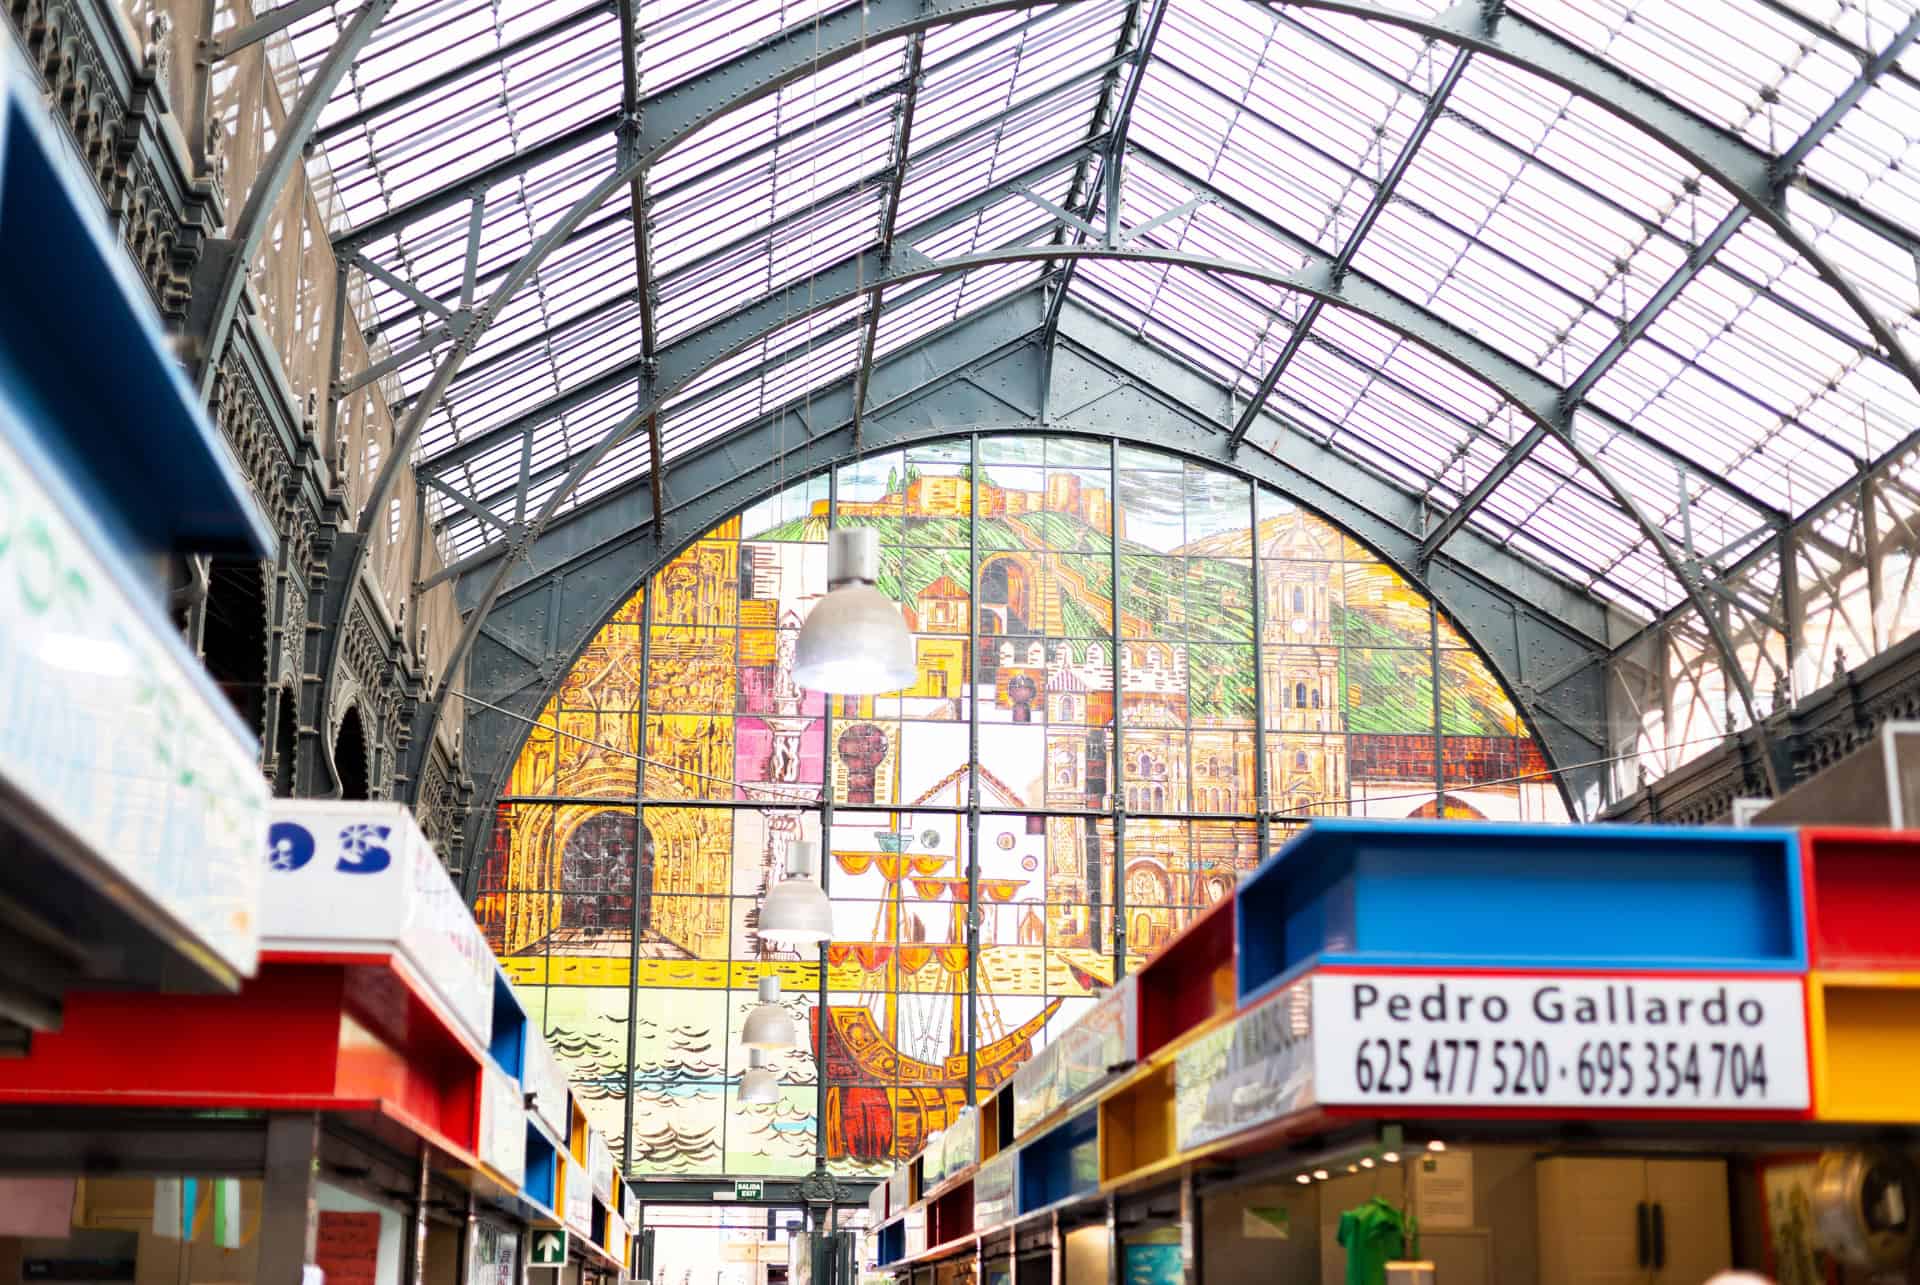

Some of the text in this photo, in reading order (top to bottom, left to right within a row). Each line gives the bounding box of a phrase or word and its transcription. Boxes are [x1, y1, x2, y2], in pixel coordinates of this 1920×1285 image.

[1352, 983, 1765, 1028] Pedro Gallardo
[1354, 1038, 1414, 1095] 625
[1422, 1038, 1481, 1095] 477
[1492, 1038, 1549, 1096] 520
[1576, 1041, 1634, 1098] 695
[1644, 1040, 1703, 1097] 354
[1710, 1041, 1768, 1099] 704
